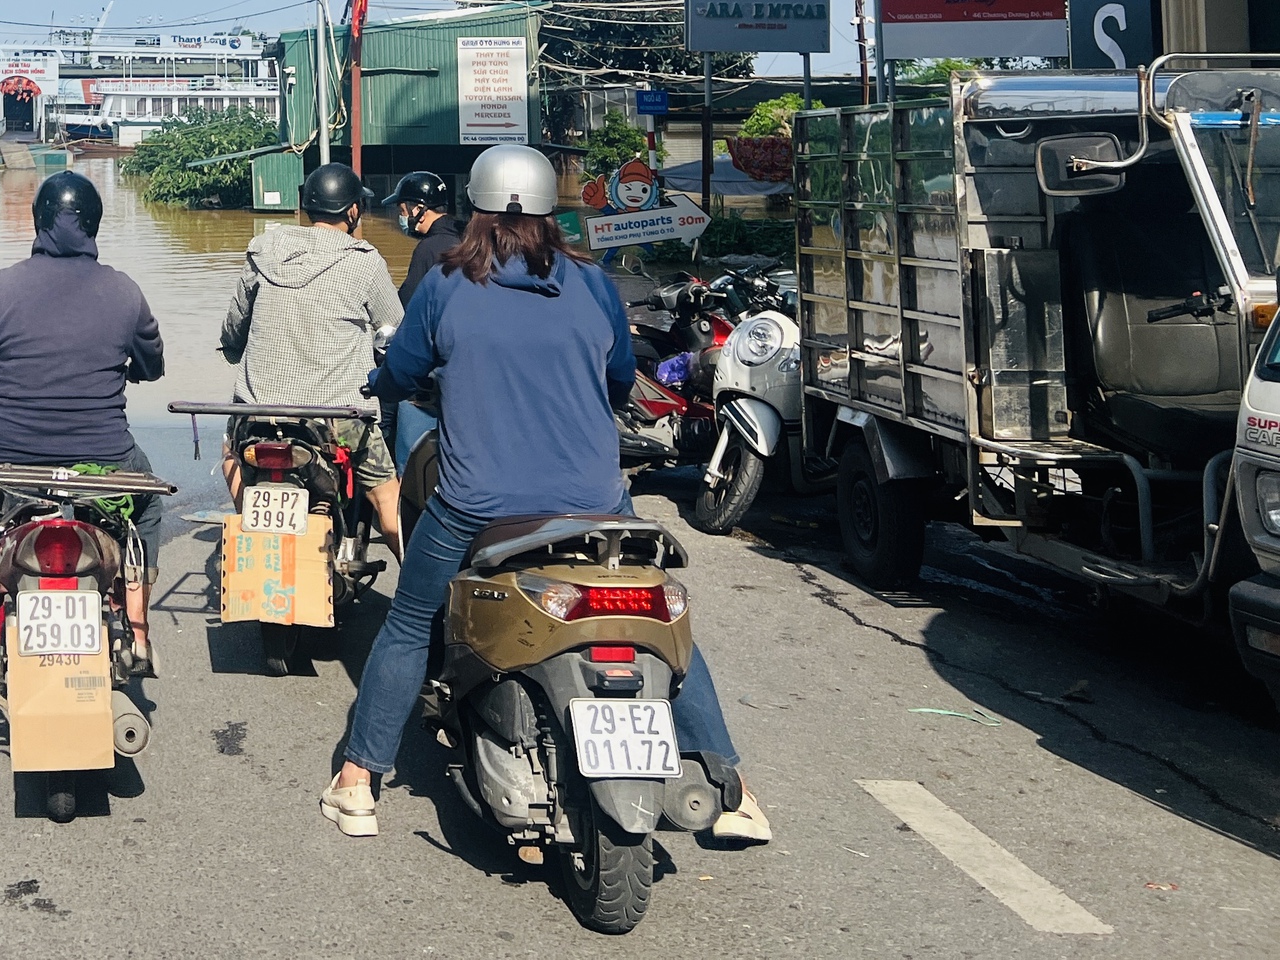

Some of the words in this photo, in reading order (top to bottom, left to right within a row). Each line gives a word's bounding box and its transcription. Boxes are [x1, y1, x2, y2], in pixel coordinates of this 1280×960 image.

[768, 2, 826, 19] MTCAR
[677, 215, 706, 227] 30m
[596, 233, 614, 243] TỔNG
[642, 229, 659, 237] TÙNG
[1247, 416, 1280, 432] SUP
[252, 490, 300, 509] 29-P7
[250, 510, 297, 530] 3994
[29, 594, 89, 622] 29-D1
[23, 623, 96, 651] 259.03
[39, 654, 81, 668] 29430
[586, 704, 660, 735] 29-E2
[584, 739, 675, 771] 011.72
